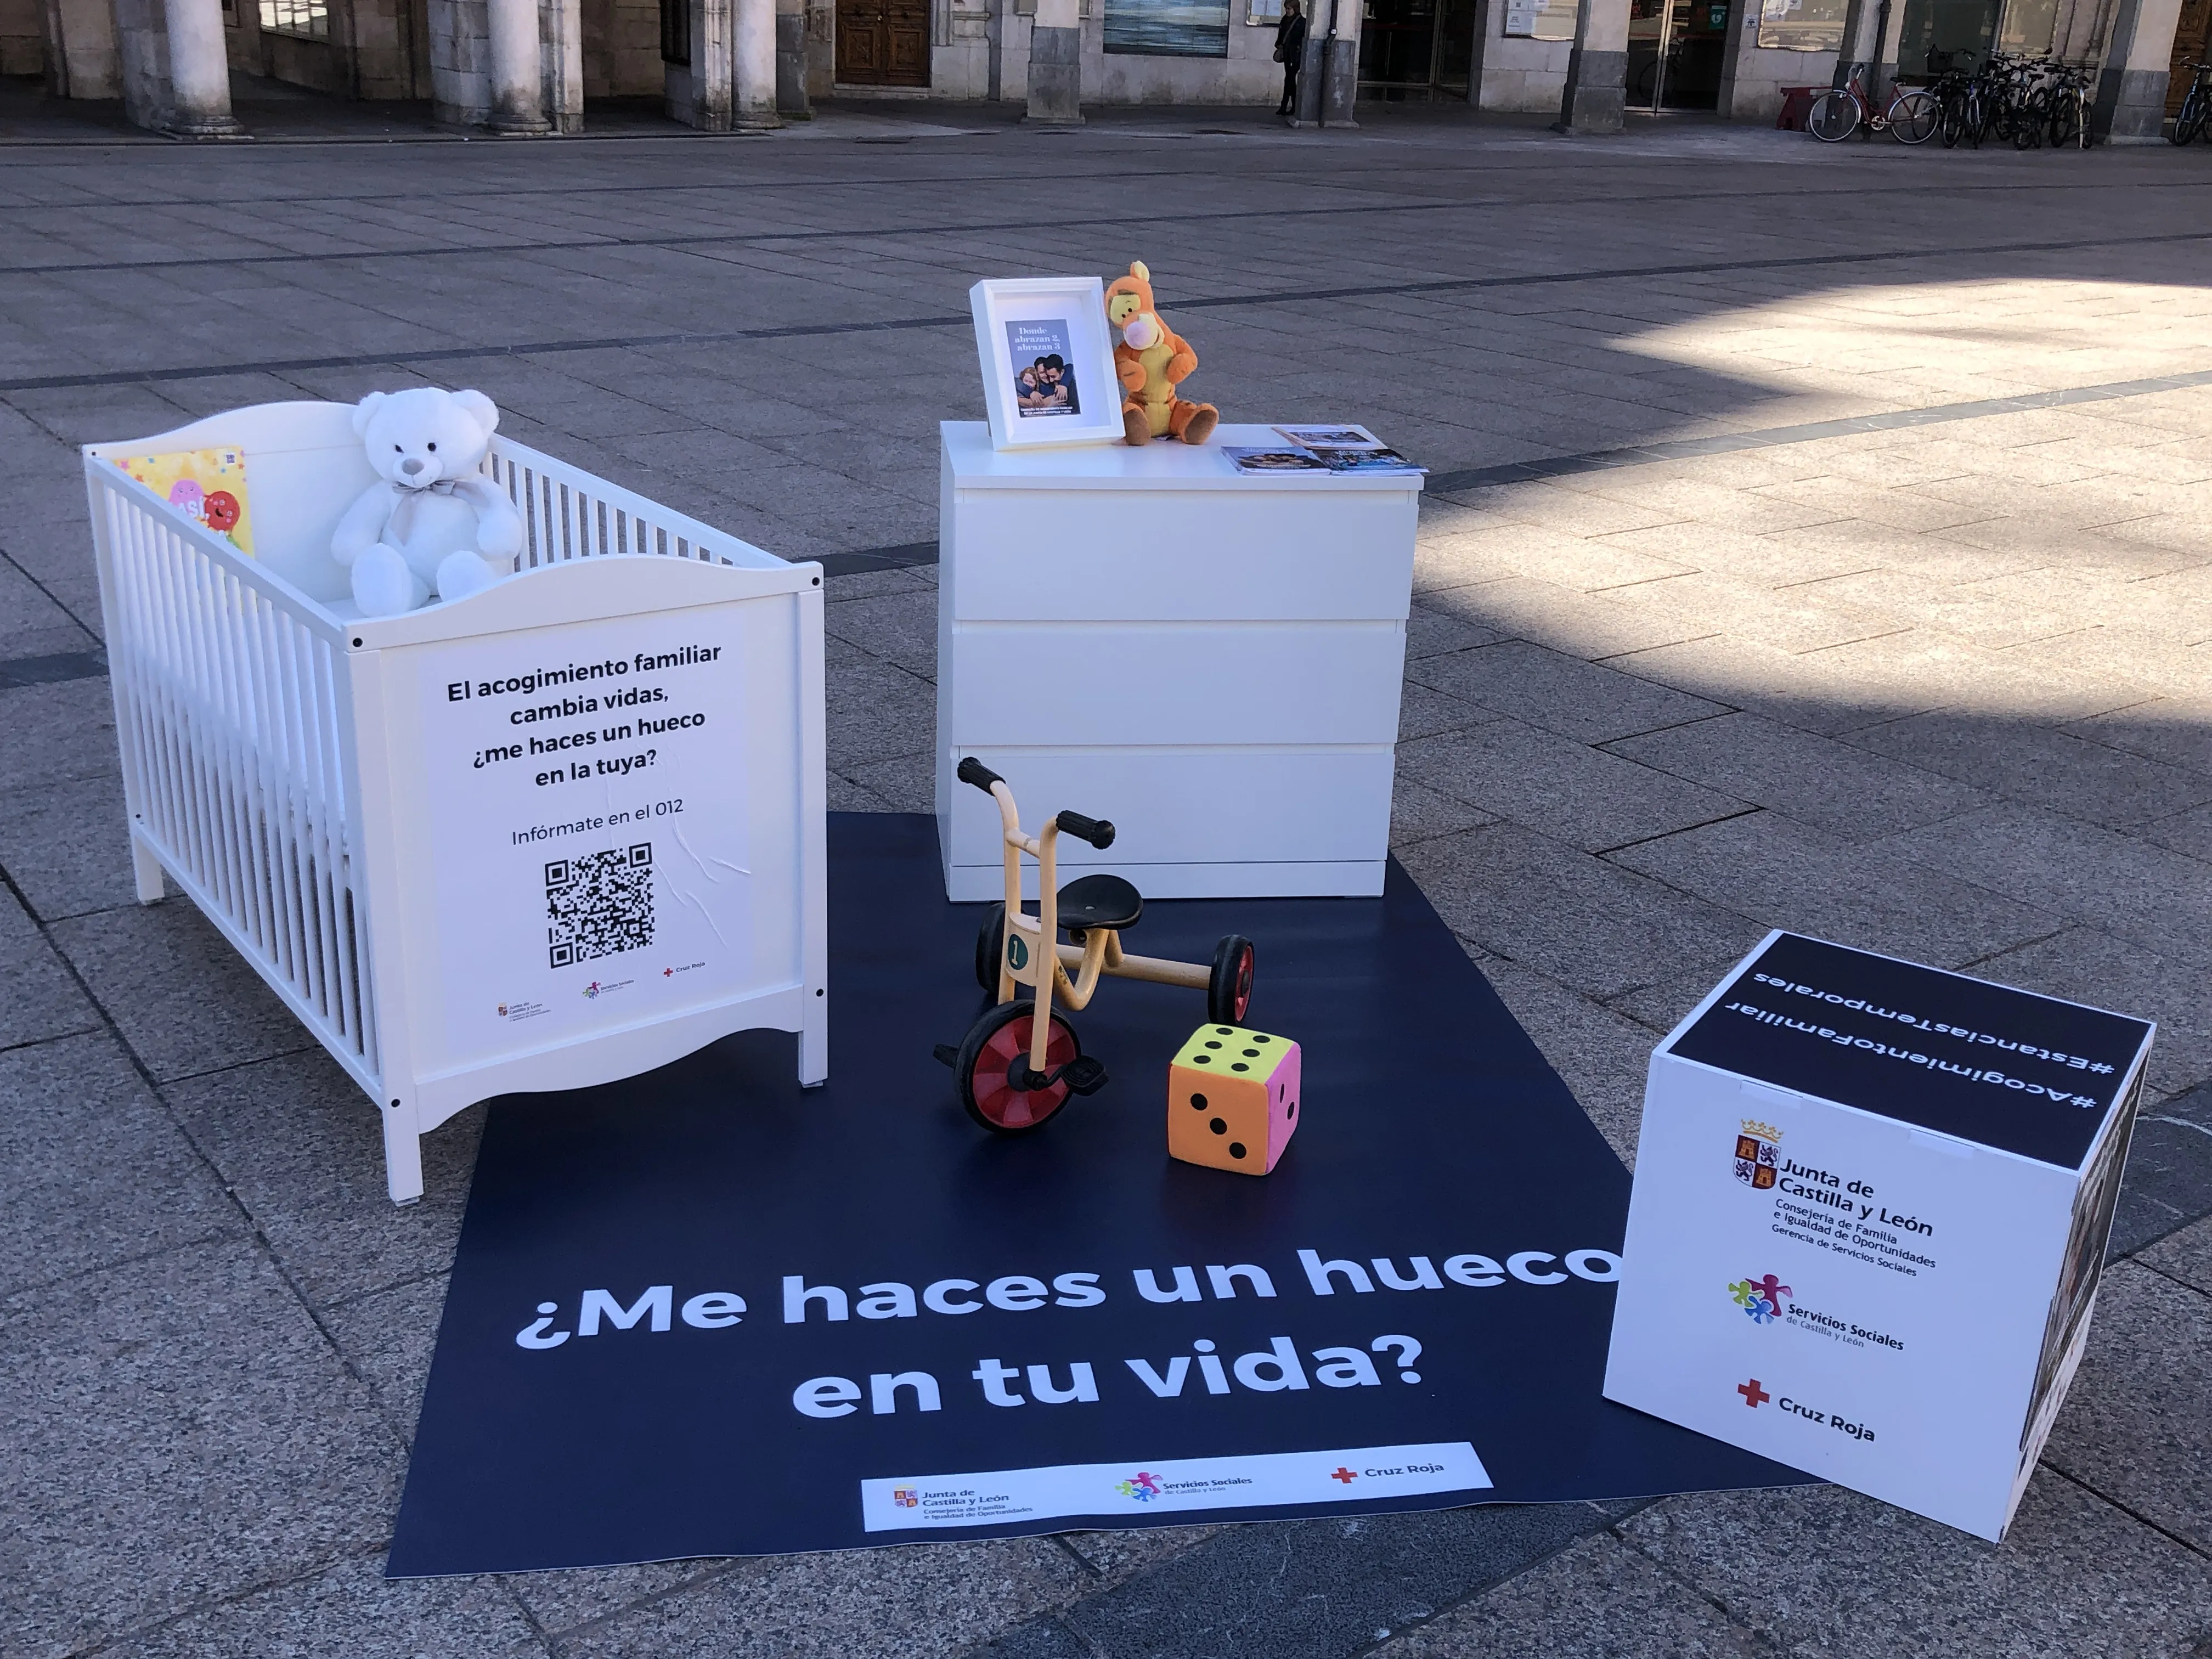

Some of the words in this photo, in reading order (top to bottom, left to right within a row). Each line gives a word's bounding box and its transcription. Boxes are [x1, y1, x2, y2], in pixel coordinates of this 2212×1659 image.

[447, 680, 471, 702] El
[477, 659, 628, 697] acogimiento
[634, 644, 721, 673] familiar
[510, 696, 598, 725] cambia
[603, 686, 669, 709] vidas,
[473, 743, 522, 769] ¿me
[530, 731, 597, 755] haces
[603, 724, 631, 741] un
[638, 712, 706, 736] hueco
[535, 767, 564, 786] en
[571, 763, 590, 780] la
[597, 749, 657, 777] tuya?
[512, 816, 603, 845] Infórmate
[608, 811, 630, 825] en
[635, 805, 650, 820] el
[655, 798, 684, 816] 012
[1753, 972, 2114, 1075] #EstanciasTemporales
[1725, 1001, 2097, 1109] #AcogimientoFamiliar
[1780, 1159, 1840, 1188] Junta
[1847, 1180, 1874, 1198] de
[1776, 1199, 1835, 1224] Consejería
[1838, 1218, 1853, 1231] de
[1856, 1223, 1897, 1245] Familia
[1779, 1177, 1853, 1212] Castilla
[1858, 1205, 1874, 1221] y
[1879, 1208, 1933, 1237] León
[1771, 1224, 1814, 1244] Gerencia
[1817, 1238, 1830, 1249] de
[1832, 1243, 1875, 1263] Servicios
[1877, 1257, 1917, 1277] Sociales
[1774, 1211, 1781, 1219] e
[1784, 1212, 1831, 1235] Igualdad
[1835, 1228, 1849, 1241] de
[1852, 1234, 1937, 1268] Oportunidades
[515, 1285, 746, 1350] ¿Me
[783, 1272, 1106, 1323] haces
[1131, 1261, 1277, 1305] un
[1296, 1246, 1622, 1296] hueco
[1786, 1316, 1798, 1325] de
[1801, 1320, 1832, 1338] Castilla
[1835, 1333, 1841, 1341] y
[1843, 1335, 1865, 1348] León
[1788, 1304, 1847, 1331] Servicios
[1850, 1325, 1904, 1351] Sociales
[793, 1369, 941, 1418] en
[971, 1357, 1102, 1405] tu
[1124, 1335, 1423, 1398] vida?
[1779, 1397, 1825, 1424] Cruz
[1831, 1414, 1876, 1442] Roja
[1163, 1480, 1209, 1489] Servicios
[1211, 1477, 1253, 1486] Sociales
[1365, 1465, 1403, 1478] Cruz
[1406, 1463, 1445, 1475] Roja
[922, 1498, 966, 1506] Castilla
[978, 1506, 1033, 1517] Oportunidades
